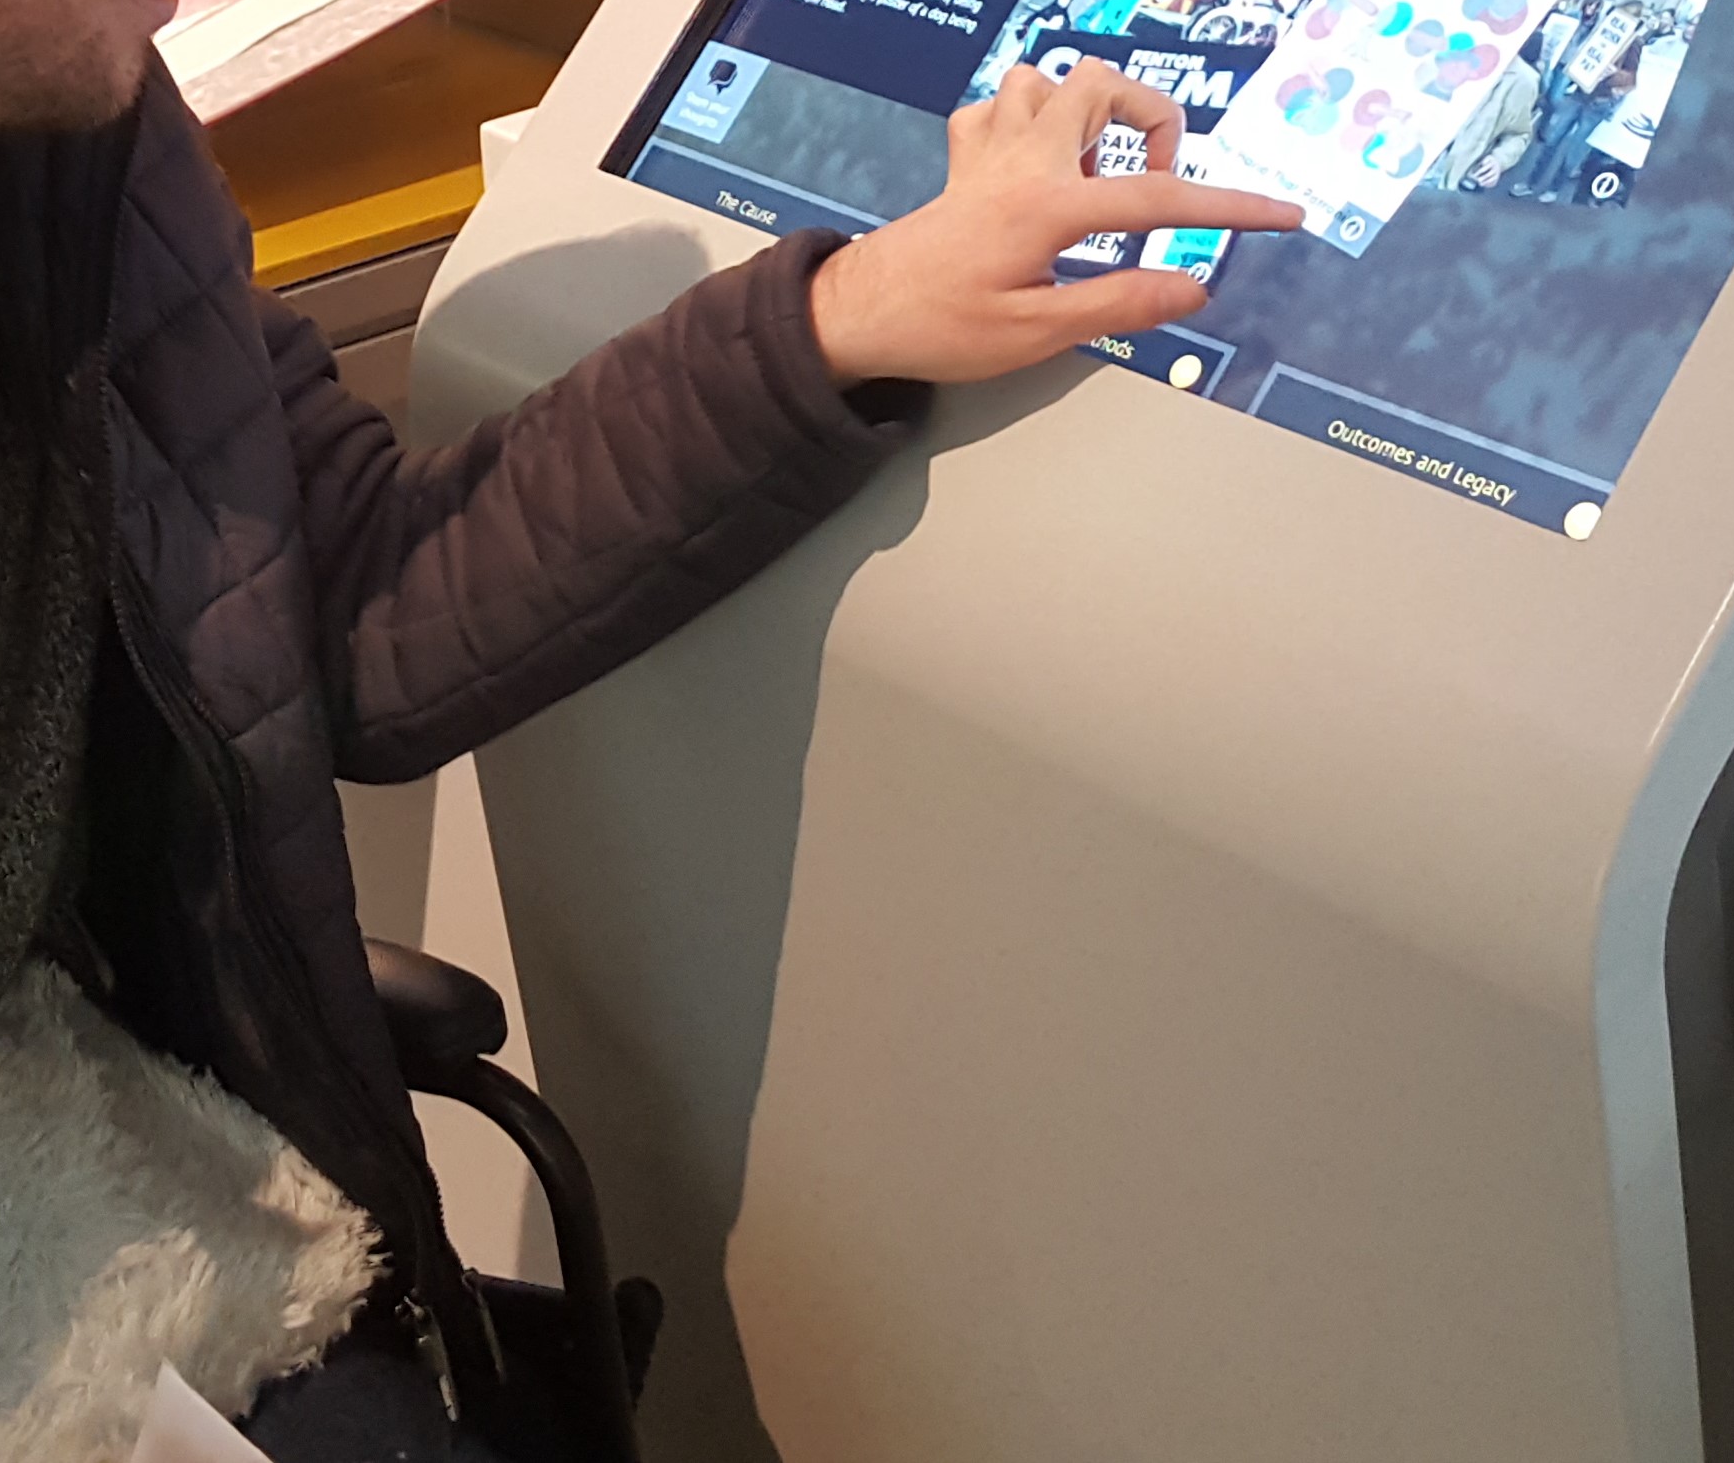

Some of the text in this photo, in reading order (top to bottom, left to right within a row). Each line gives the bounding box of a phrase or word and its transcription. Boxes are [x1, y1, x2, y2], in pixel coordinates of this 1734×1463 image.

[1128, 49, 1205, 71] FENTON
[716, 190, 777, 226] The Cause
[1327, 420, 1517, 507] Outcomes and Legacy
